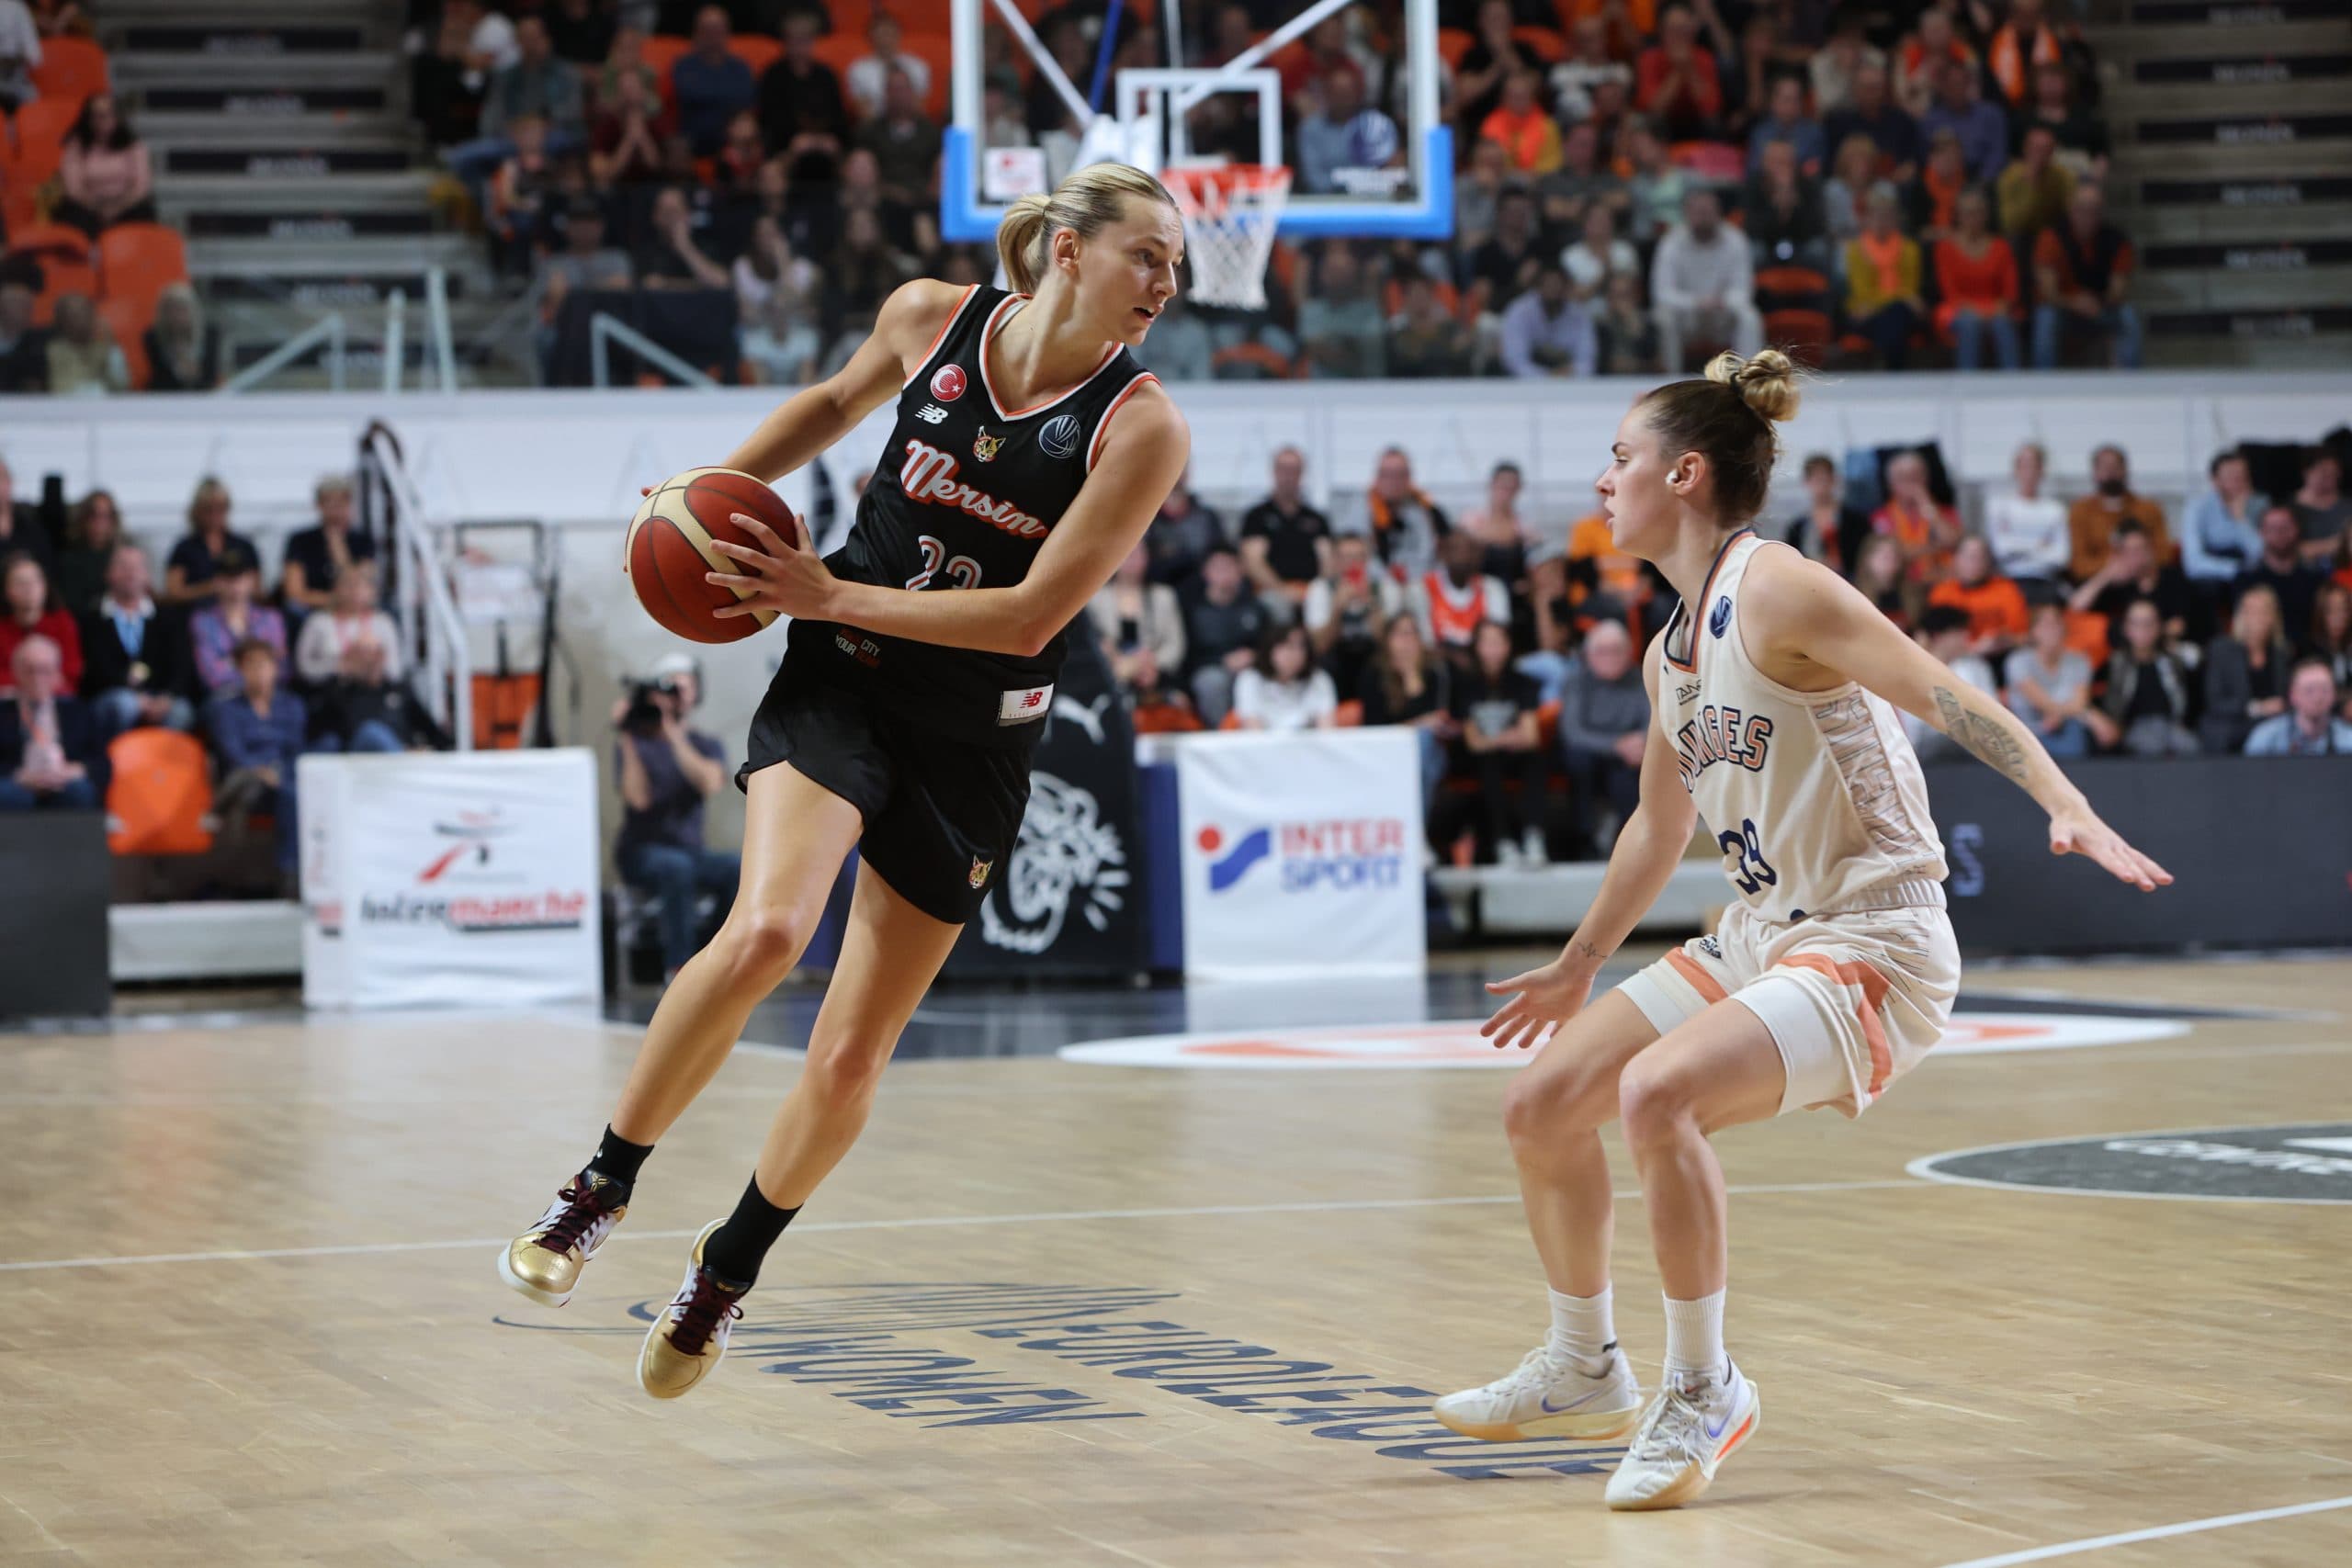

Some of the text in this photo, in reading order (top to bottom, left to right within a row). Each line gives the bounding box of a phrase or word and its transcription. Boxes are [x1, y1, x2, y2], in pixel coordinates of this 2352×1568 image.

[899, 439, 1049, 539] Mersin
[836, 634, 857, 656] YOUR
[860, 638, 881, 656] CITY
[1281, 819, 1404, 856] INTER
[1718, 818, 1777, 896] 39
[1280, 854, 1402, 893] SPORT
[724, 1334, 1148, 1429] WOMEN
